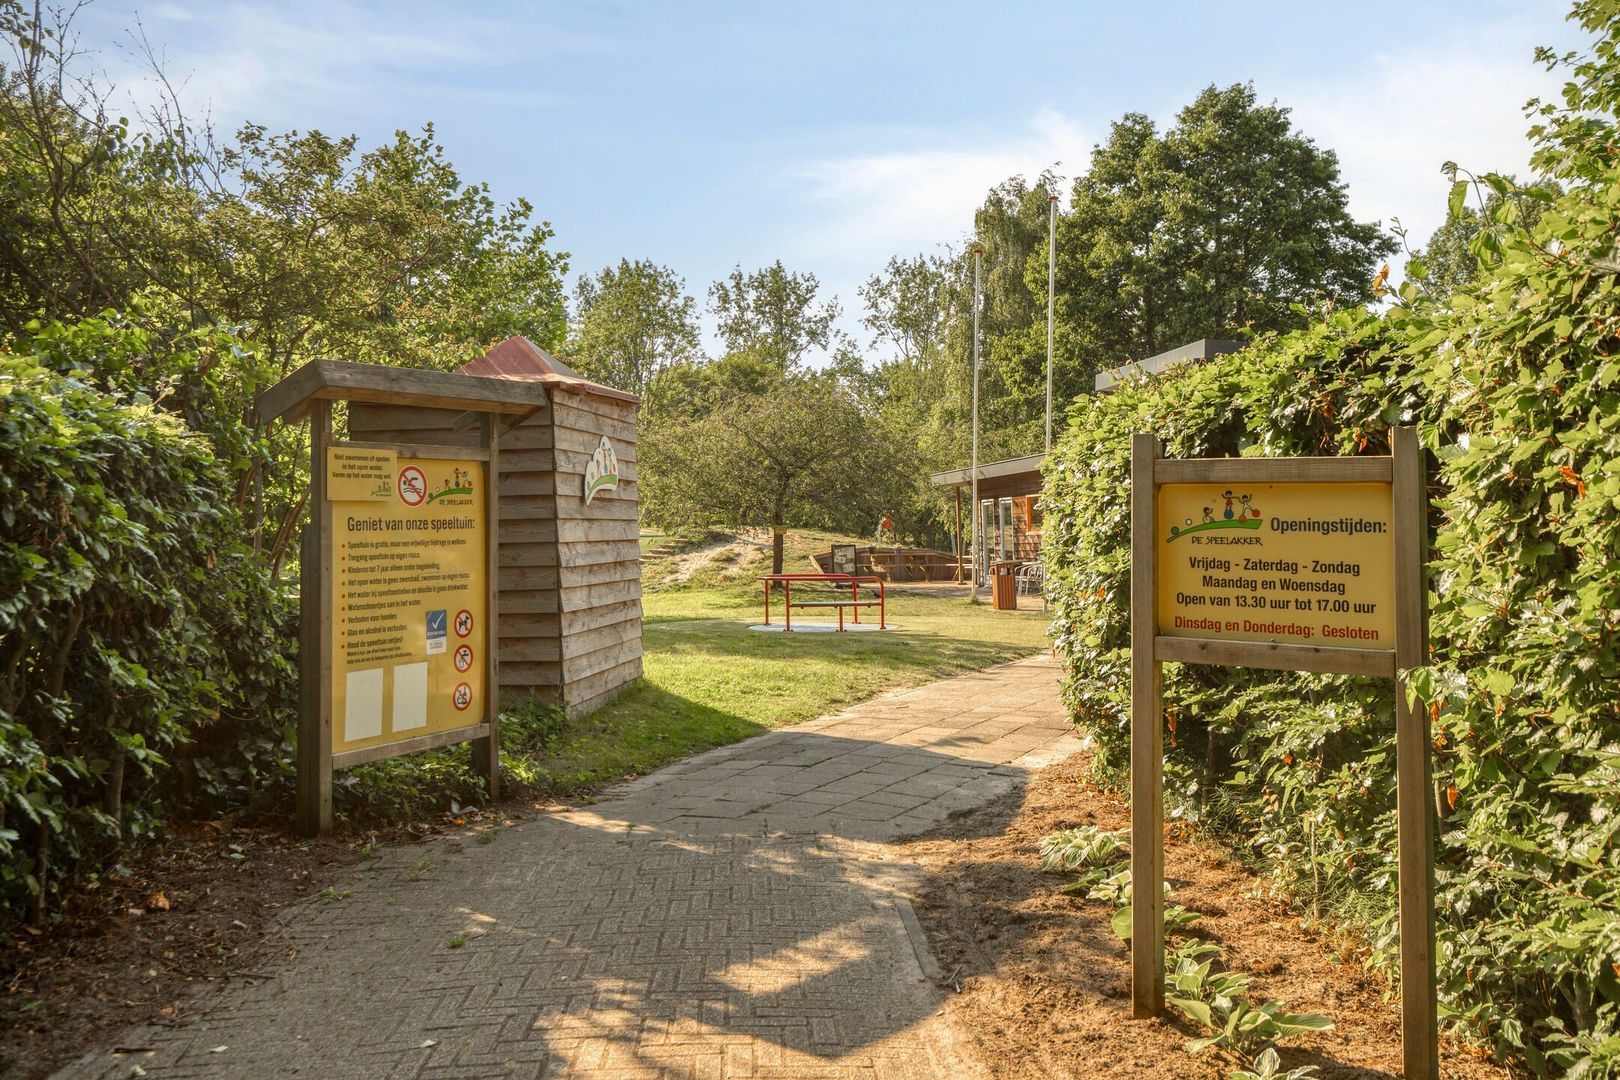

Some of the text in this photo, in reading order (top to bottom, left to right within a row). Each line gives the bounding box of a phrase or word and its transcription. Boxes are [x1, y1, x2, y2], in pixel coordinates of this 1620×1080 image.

[347, 516, 475, 533] Geniet van onze speeltuin:
[1270, 517, 1387, 535] Openingstijden:
[348, 541, 369, 550] Speeltuin
[1191, 535, 1263, 546] DE SPEELAKKER
[348, 553, 368, 562] Toegang
[368, 553, 388, 561] speeltuin
[1189, 556, 1231, 573] Vrijdag
[1243, 558, 1298, 574] Zaterdag
[1311, 560, 1360, 577] Zondag
[348, 578, 356, 586] Het
[356, 579, 368, 587] open
[1202, 575, 1345, 596] Maandag en Woensdag
[348, 591, 356, 599] Het
[1176, 592, 1377, 614] Open van 13.30 uur tot 17.00 uur
[348, 616, 369, 624] Verboden
[1174, 616, 1379, 641] Dinsdag en Donderdag: Gesloten
[347, 641, 359, 649] Houd
